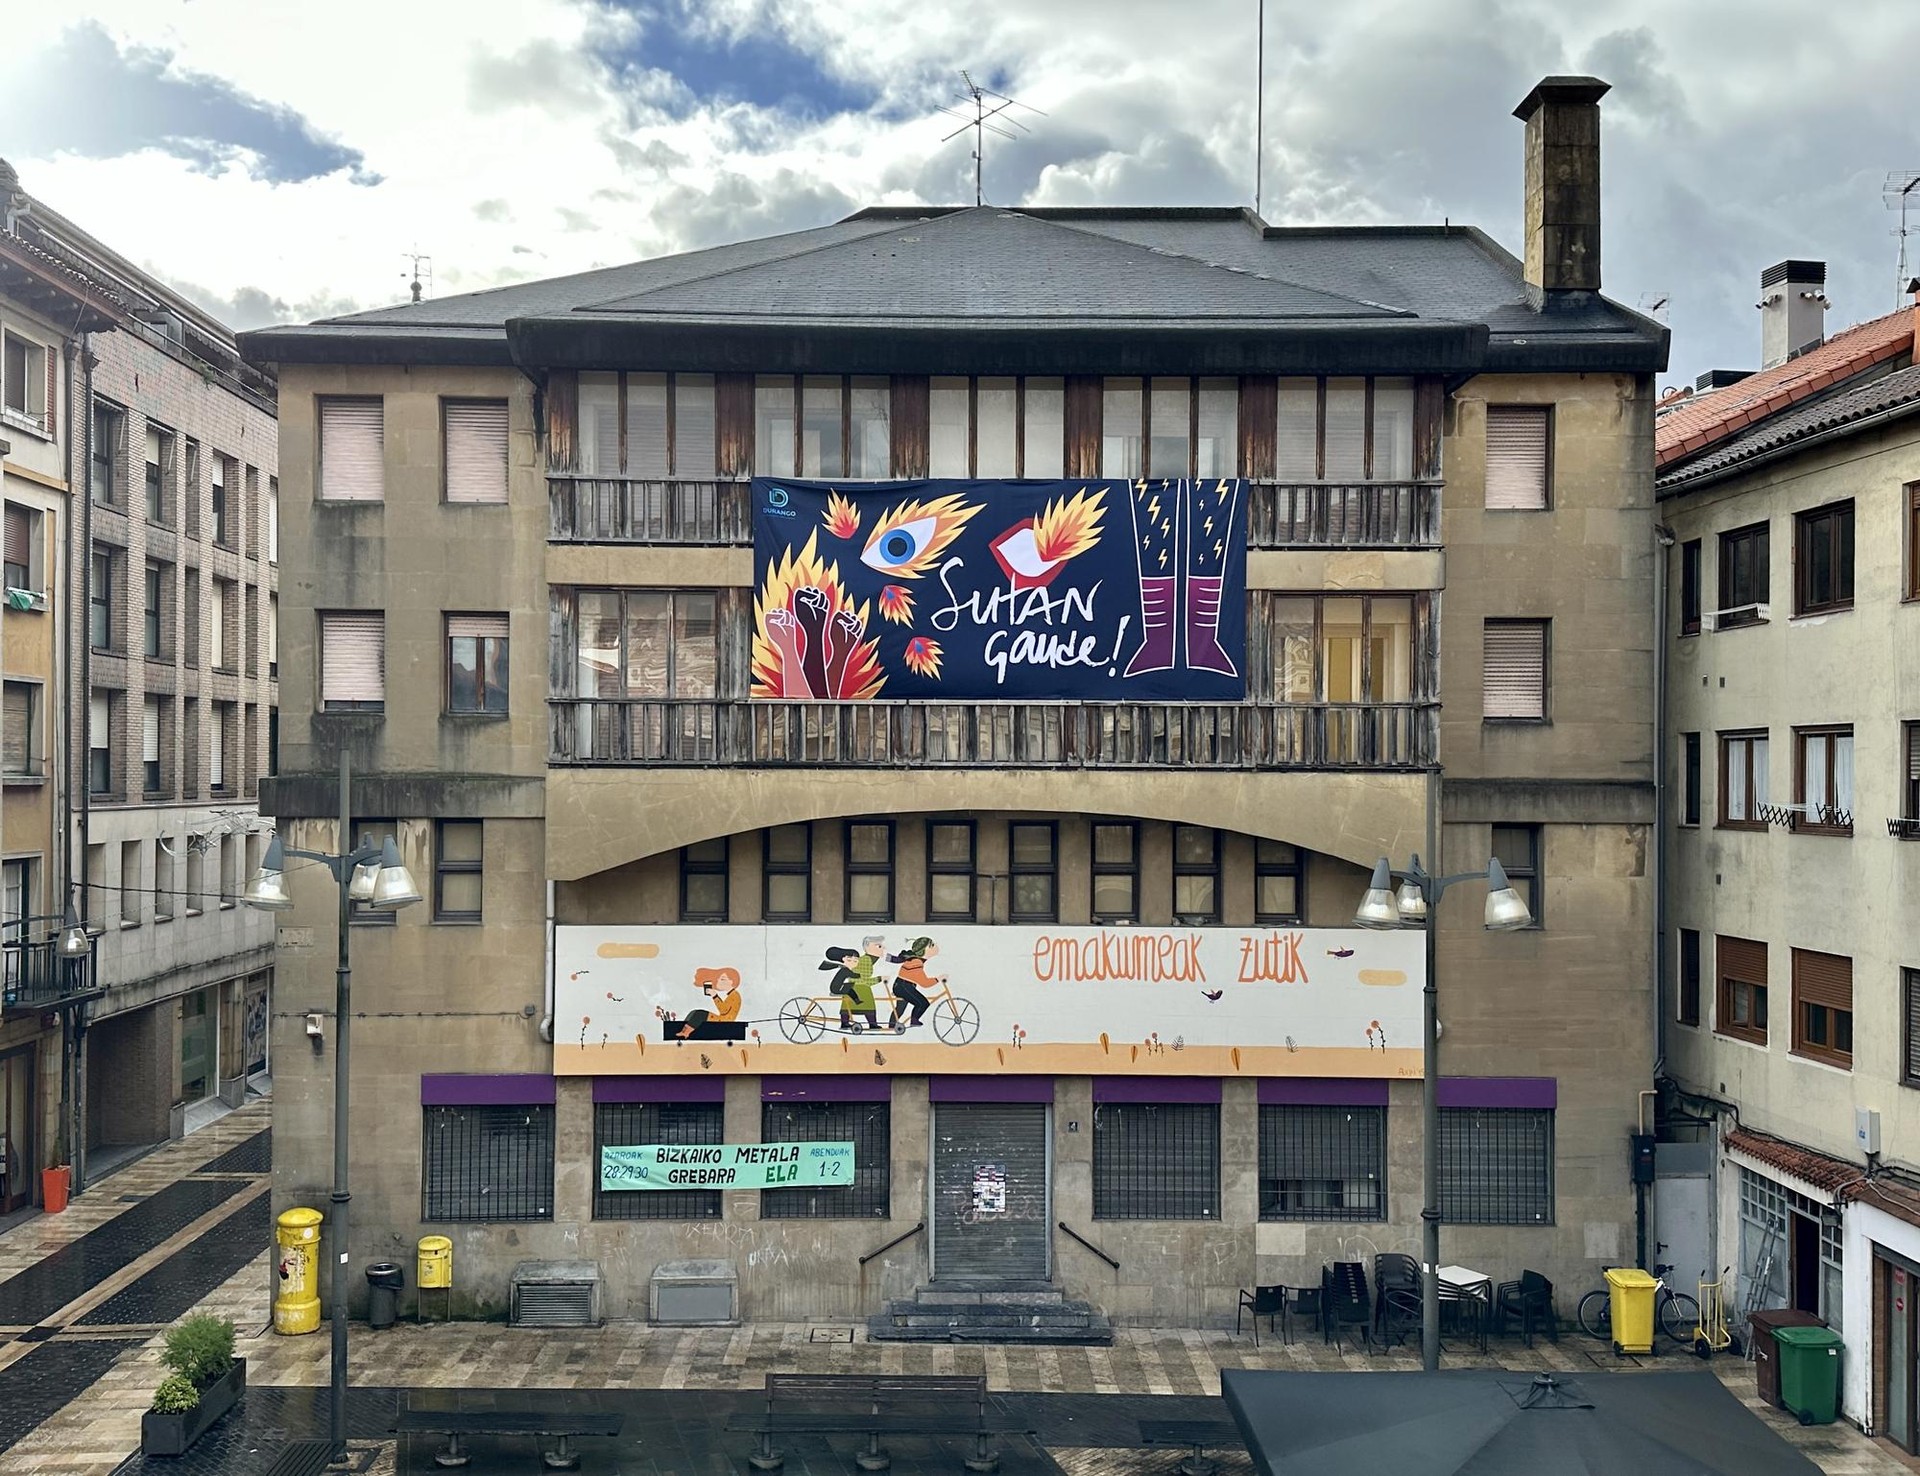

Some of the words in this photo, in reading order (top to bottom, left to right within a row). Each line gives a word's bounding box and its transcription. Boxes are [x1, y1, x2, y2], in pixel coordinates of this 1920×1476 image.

[762, 507, 797, 517] DURANGO
[1033, 931, 1207, 983] emakumeak
[656, 1147, 722, 1164] BIZKAIKO
[735, 1146, 800, 1164] METALA
[809, 1147, 850, 1157] ABENDUAK
[668, 1168, 736, 1184] GREBARA
[765, 1164, 798, 1182] ELA
